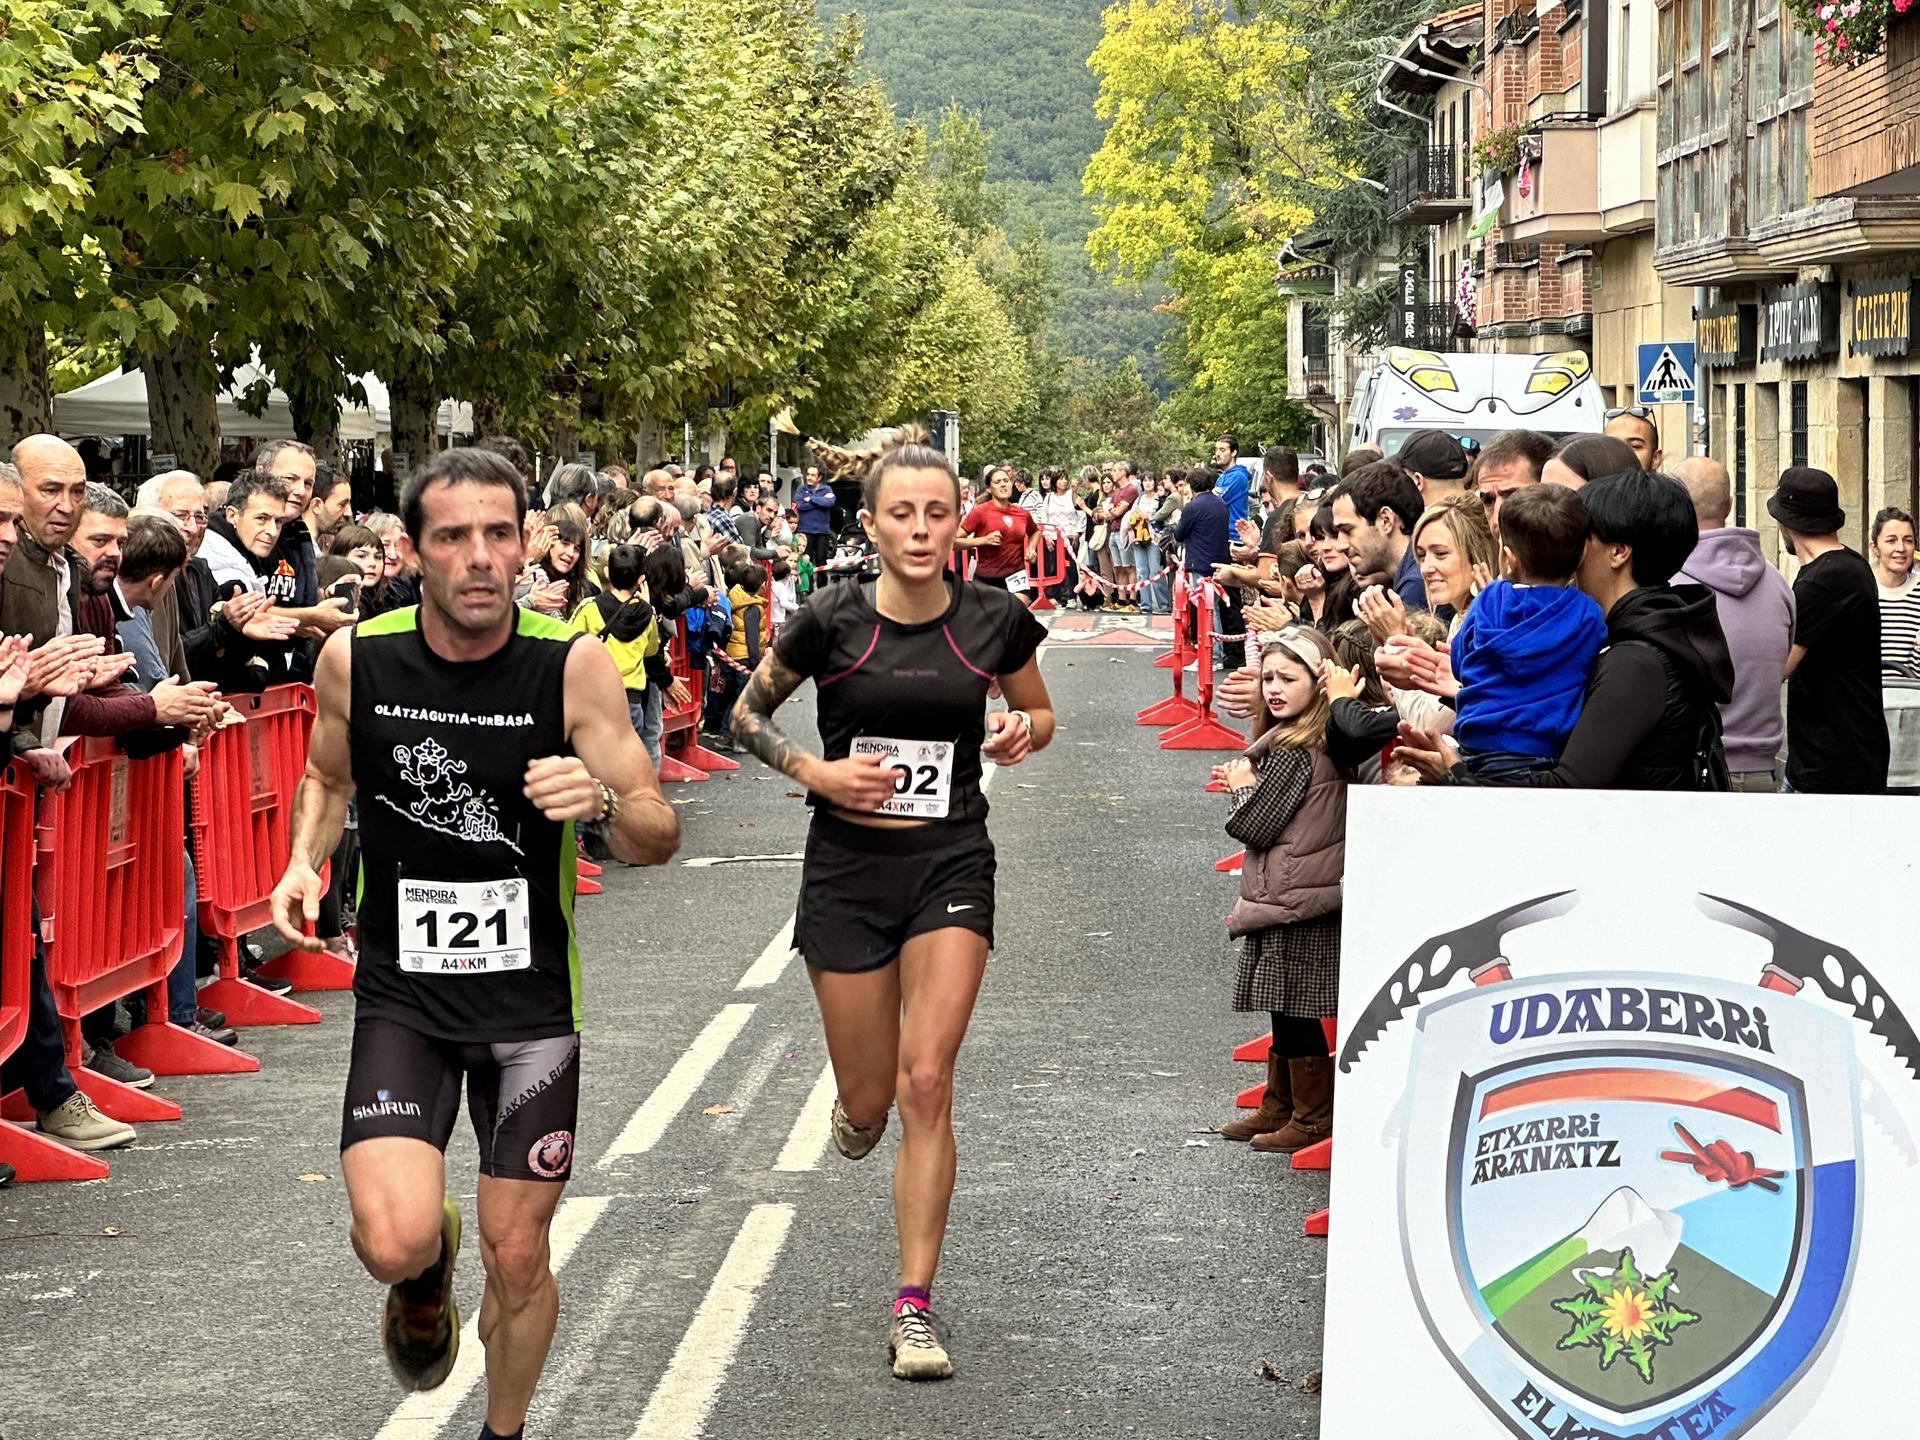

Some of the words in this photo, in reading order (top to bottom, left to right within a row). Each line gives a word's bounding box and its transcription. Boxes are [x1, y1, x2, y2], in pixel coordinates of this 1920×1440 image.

[1404, 269, 1415, 305] CAFE
[1404, 311, 1415, 338] BAR
[1855, 291, 1908, 342] CAFETERIA
[856, 742, 899, 754] MENDIRA
[889, 763, 939, 795] 02
[405, 887, 458, 900] MENDIRA
[416, 908, 507, 948] 121
[441, 957, 487, 970] A4XKM
[498, 1079, 549, 1121] SAKANA
[1470, 1140, 1621, 1187] ARANATZ
[1511, 1380, 1737, 1440] ELKTEA
